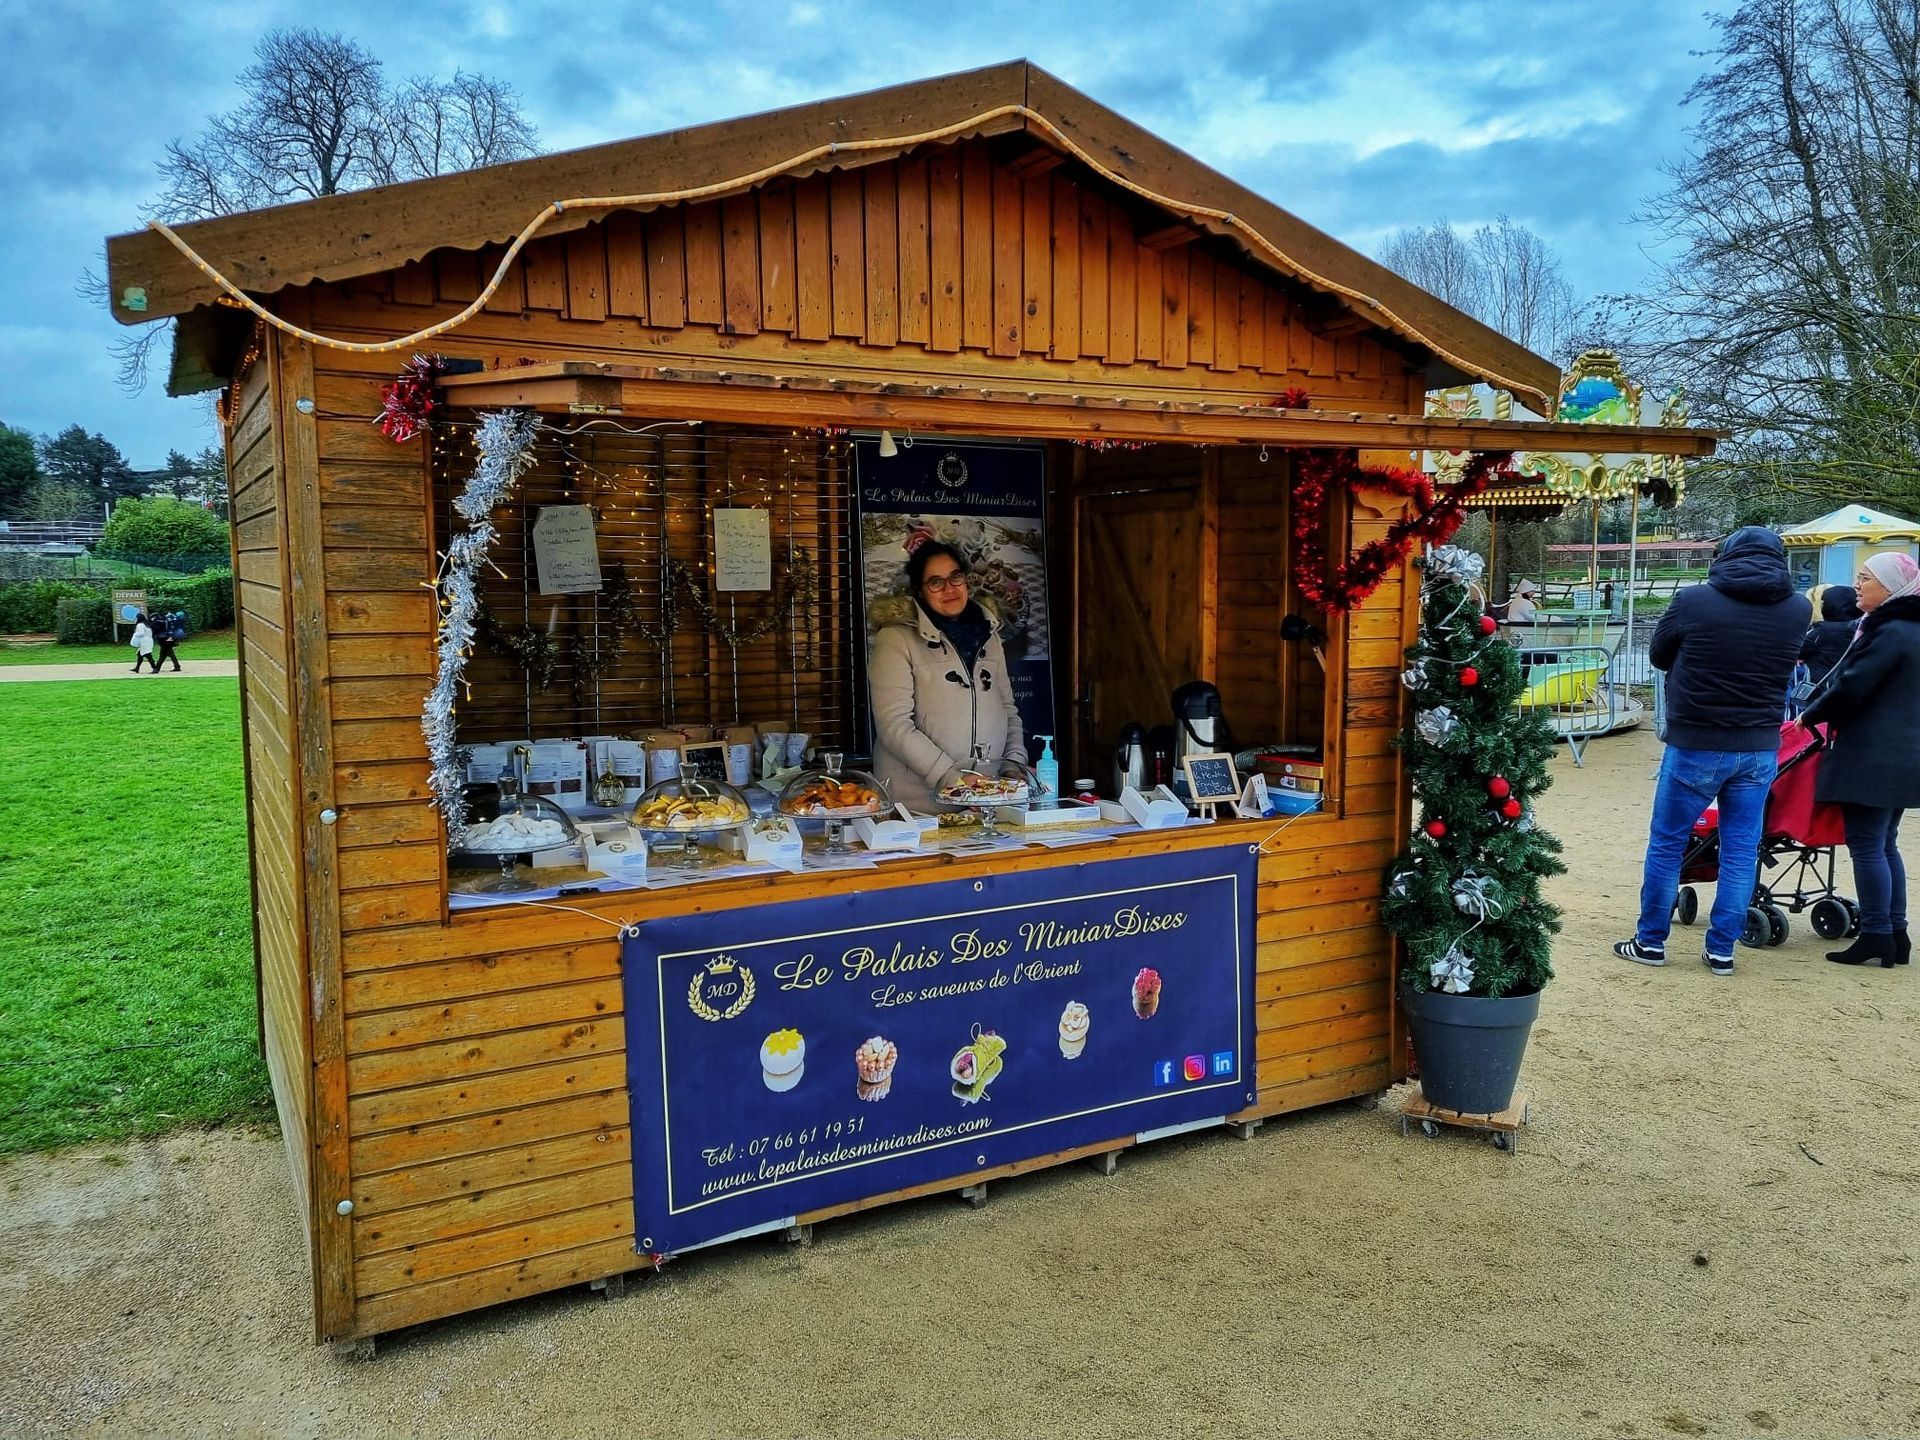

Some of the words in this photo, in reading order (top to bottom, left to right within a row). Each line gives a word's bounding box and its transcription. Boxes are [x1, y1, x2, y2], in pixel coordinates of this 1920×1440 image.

[865, 487, 887, 502] Le
[891, 487, 931, 504] Palais
[934, 489, 960, 504] Des
[963, 491, 1037, 508] MiniarDises
[774, 954, 834, 990] Le
[842, 941, 944, 981] Palais
[951, 928, 1012, 964] Des
[1019, 905, 1188, 952] MiniarDises
[707, 982, 738, 999] MD
[871, 984, 917, 1008] Les
[919, 978, 987, 1001] saveurs
[989, 969, 1011, 988] de
[1013, 959, 1082, 985] l'Orient
[1215, 1056, 1230, 1072] in
[701, 1143, 736, 1167] Tél
[749, 1137, 769, 1156] 07
[774, 1131, 794, 1149] 66
[800, 1125, 819, 1144] 61
[825, 1120, 842, 1139] 19
[847, 1116, 865, 1134] 51
[701, 1115, 993, 1196] www.lepalaisdesminiardises.com
